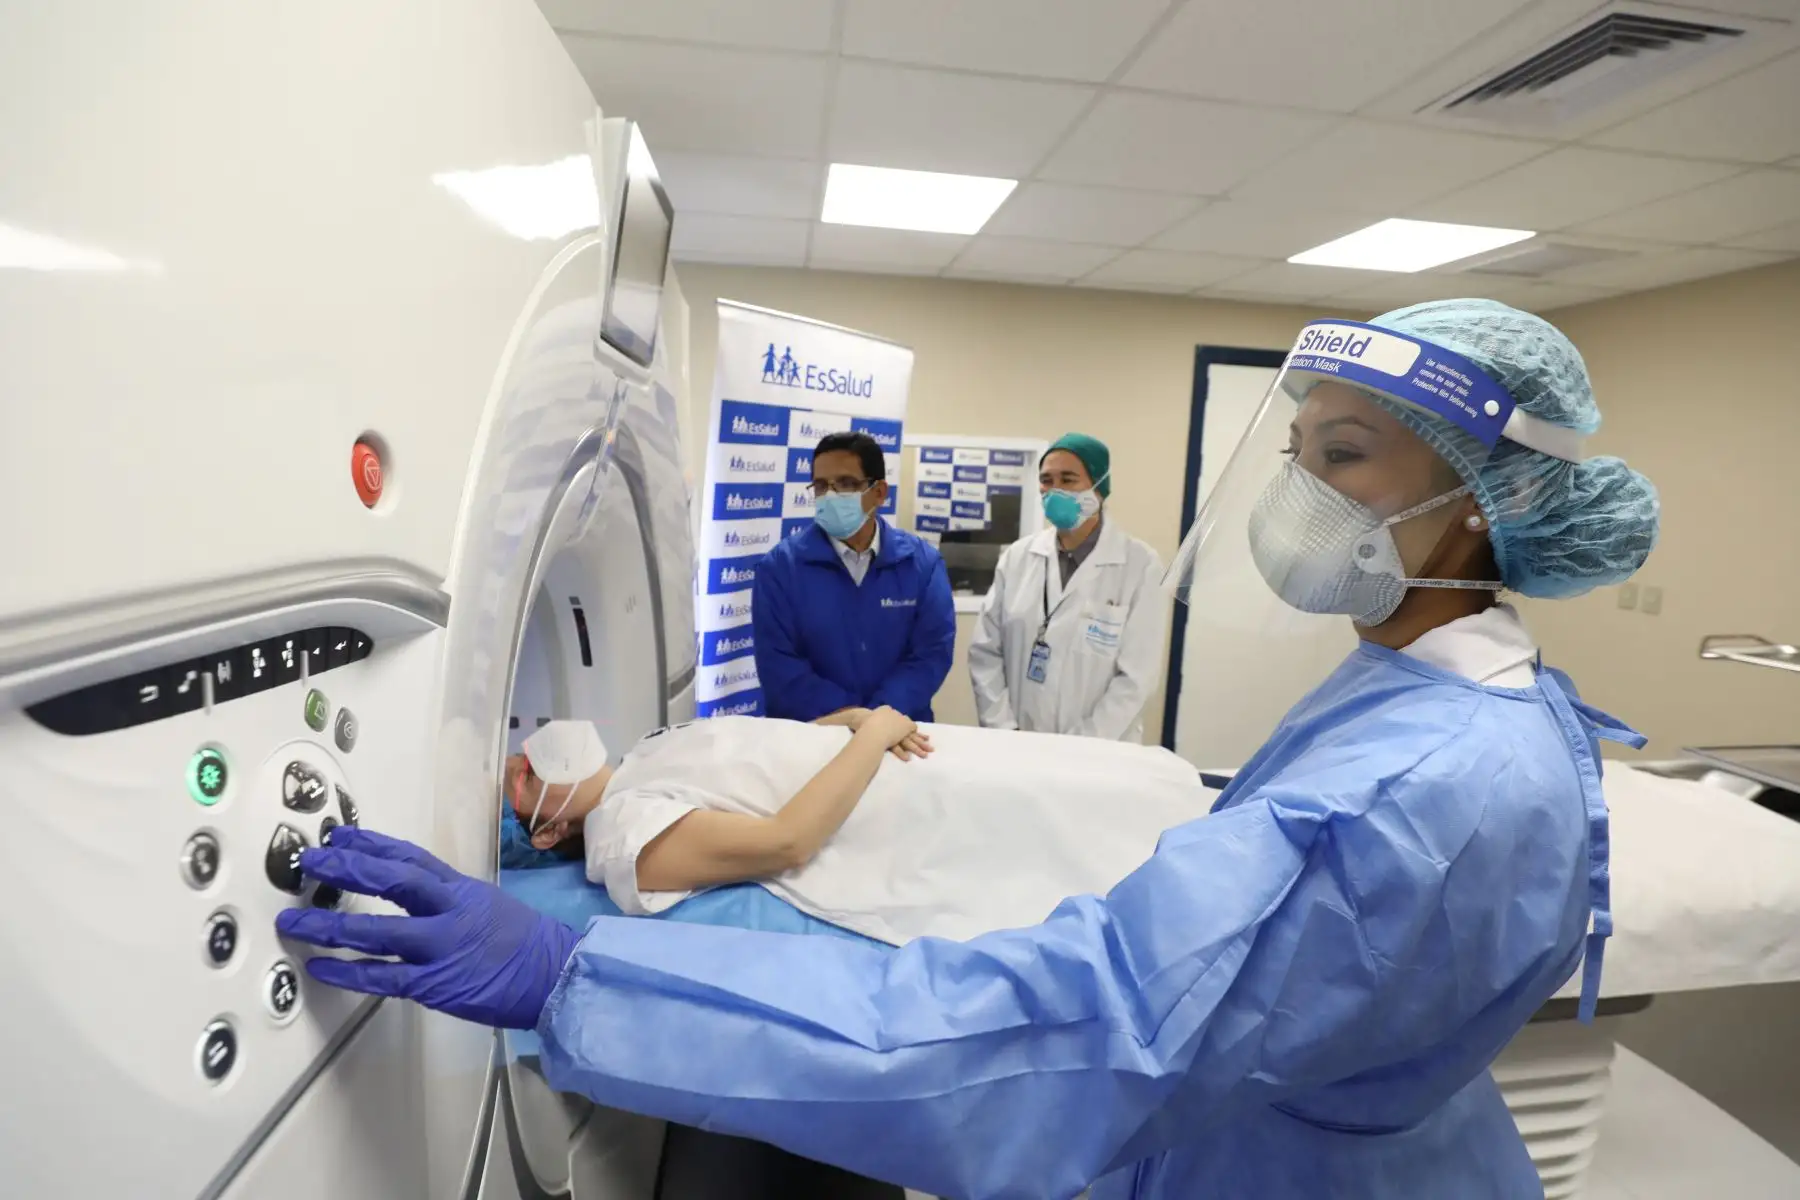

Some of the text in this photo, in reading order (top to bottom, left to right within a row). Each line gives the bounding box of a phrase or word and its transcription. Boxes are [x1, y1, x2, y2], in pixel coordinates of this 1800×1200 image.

[1299, 329, 1373, 358] Shield
[1313, 357, 1342, 373] Mask
[805, 364, 874, 398] EsSalud
[1411, 377, 1438, 394] Protective
[1449, 394, 1466, 408] before
